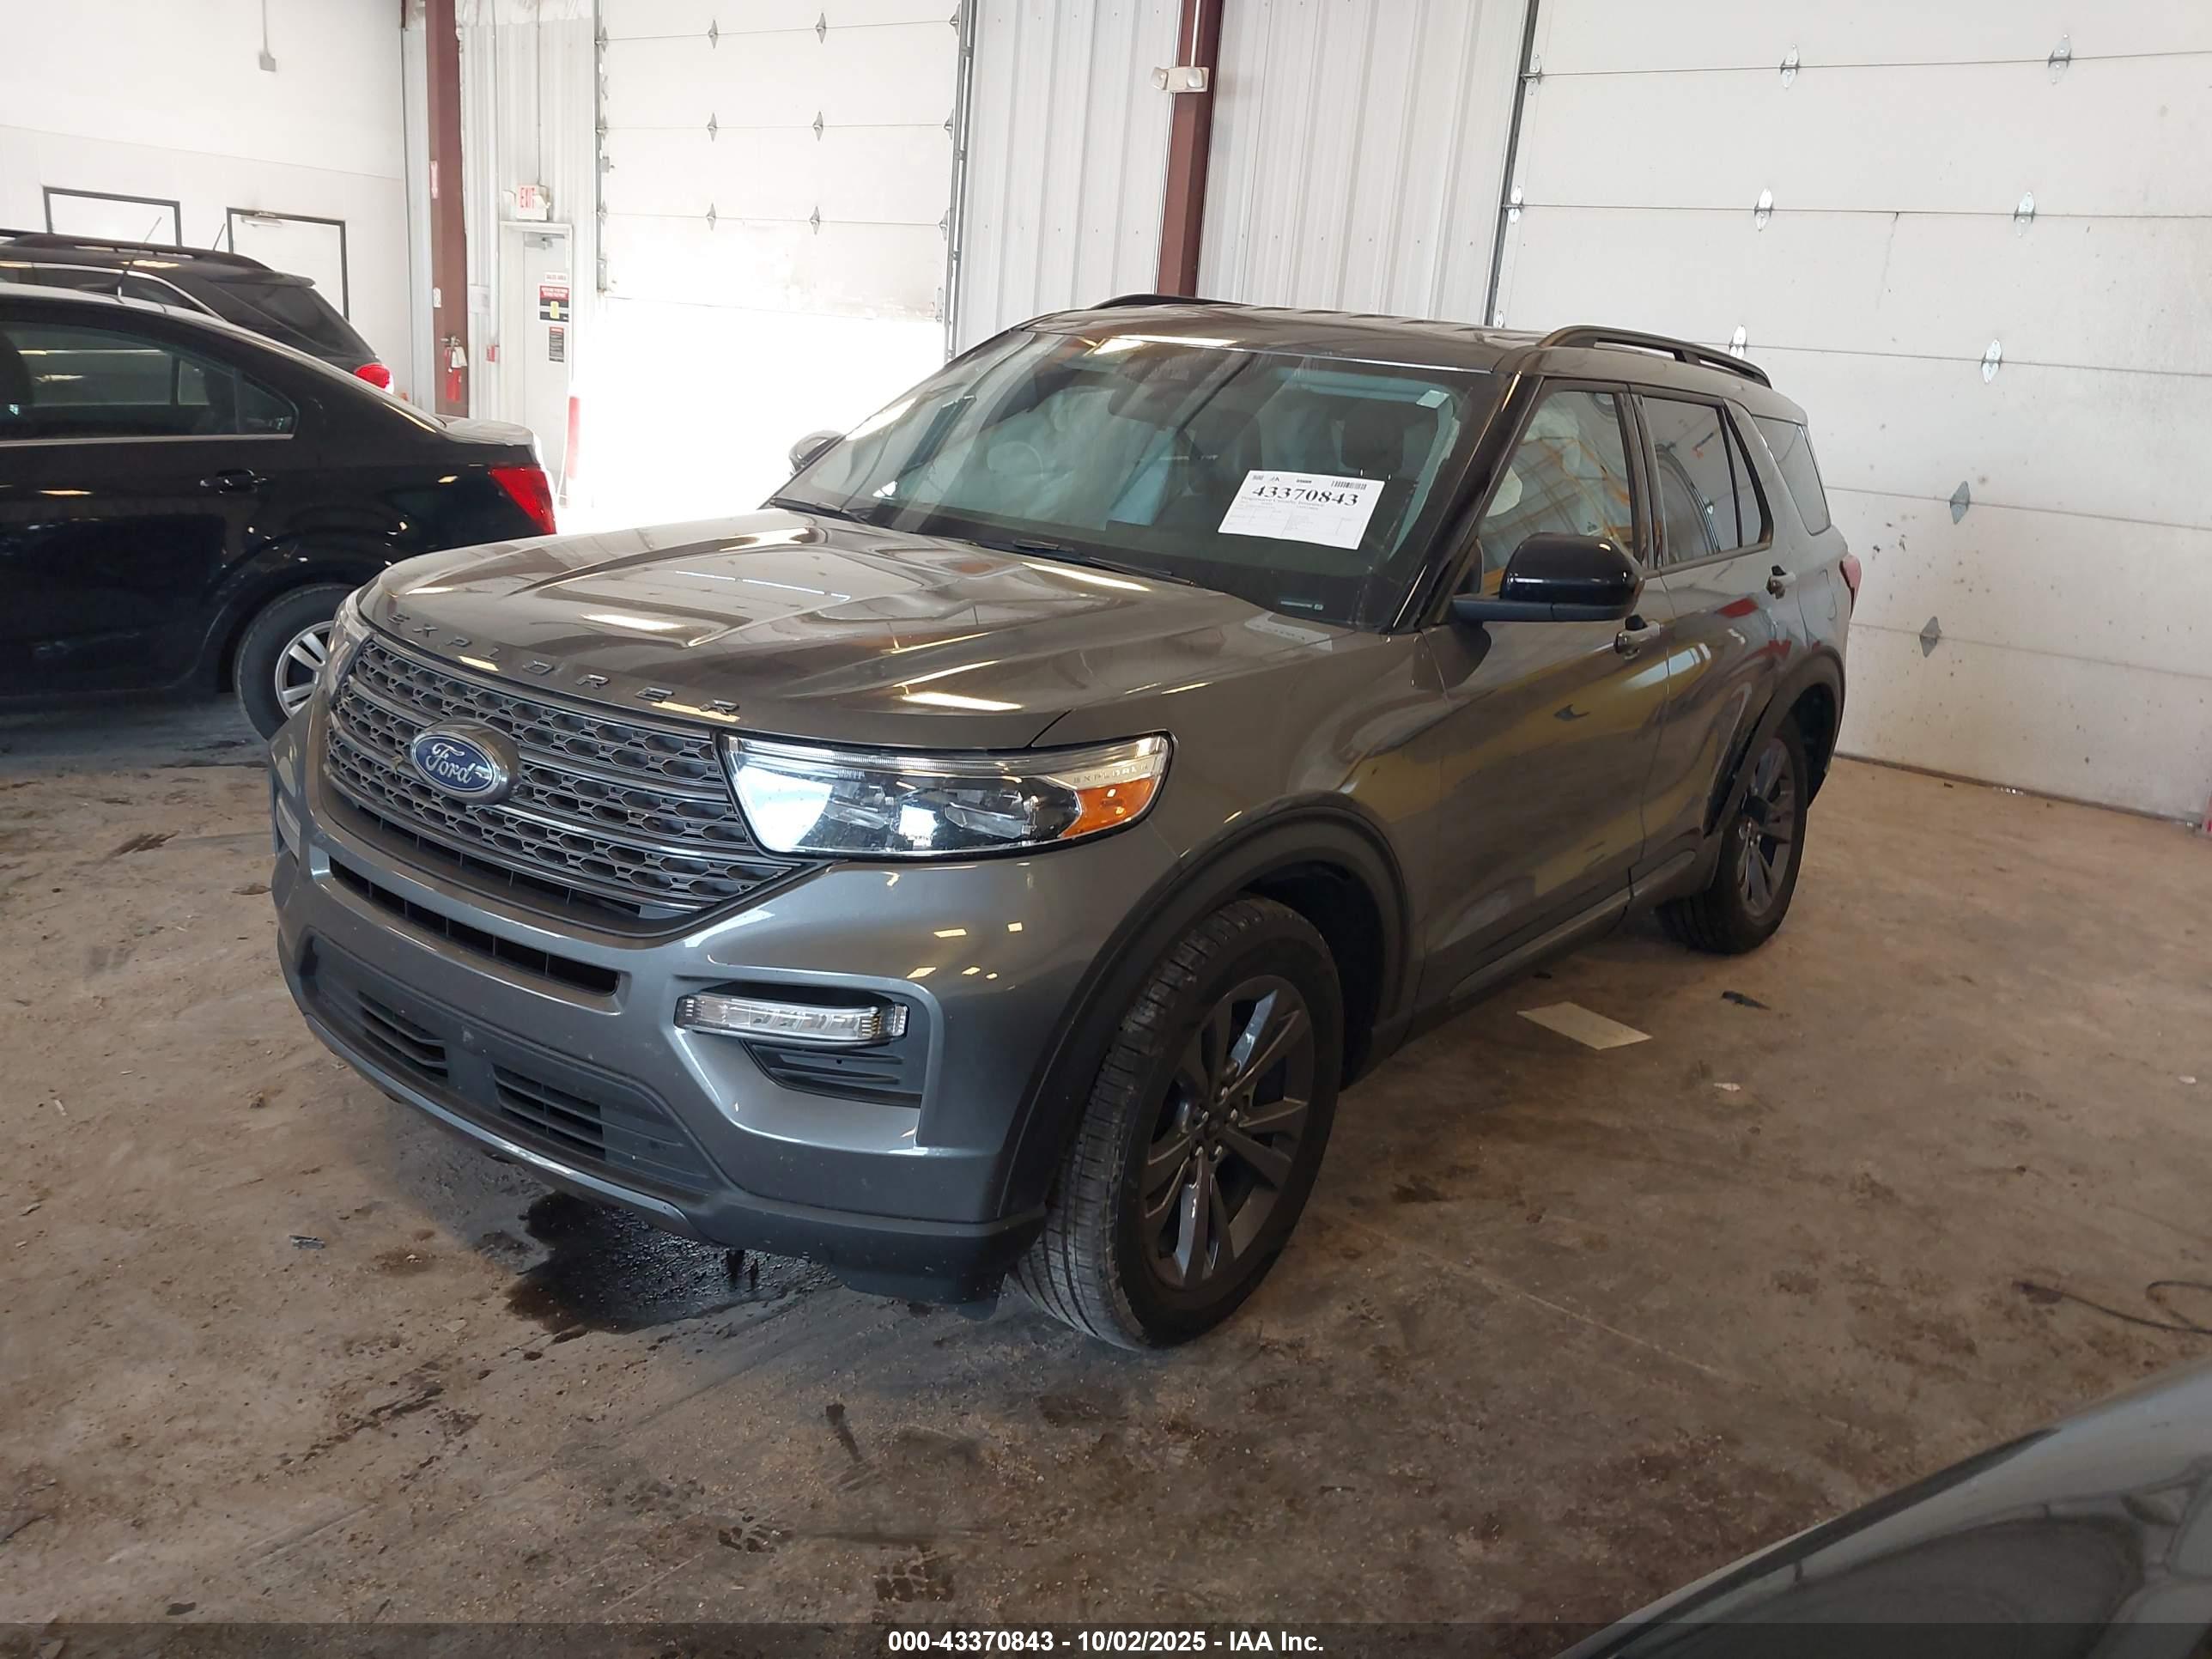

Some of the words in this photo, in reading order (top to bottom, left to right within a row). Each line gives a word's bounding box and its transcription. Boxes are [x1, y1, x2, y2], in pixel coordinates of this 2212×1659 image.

[1253, 485, 1359, 507] 43370843
[386, 612, 739, 714] EXPLORER
[426, 743, 476, 783] Ford
